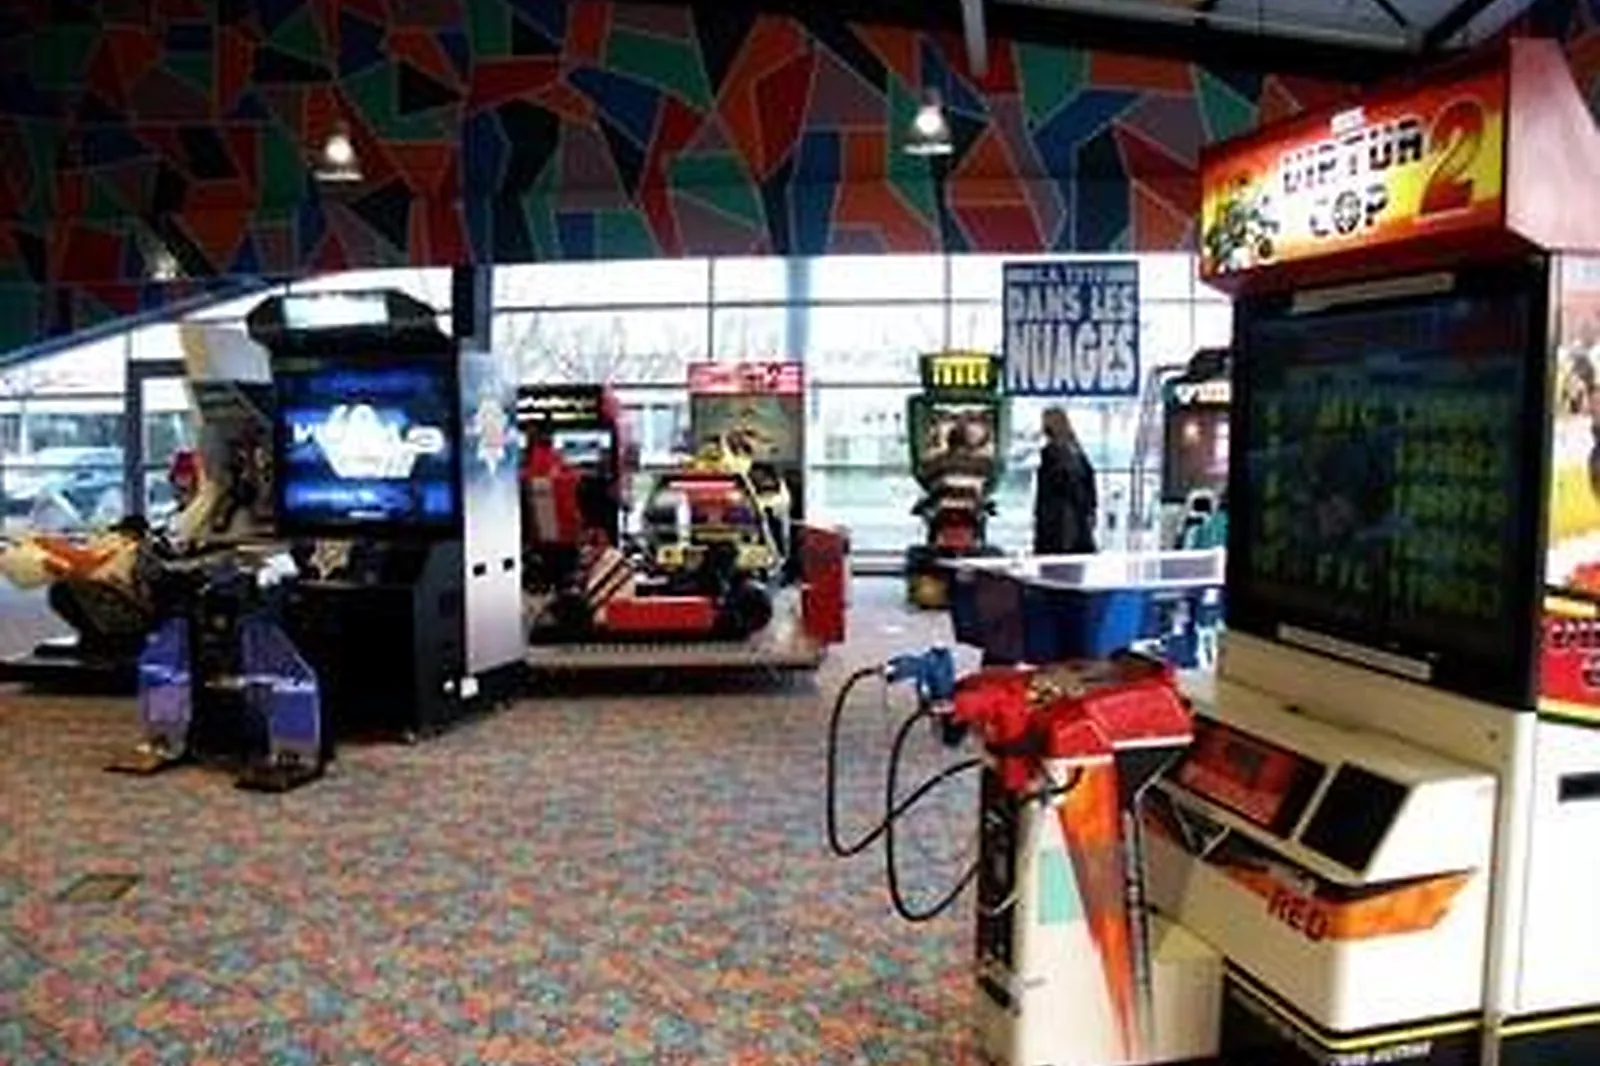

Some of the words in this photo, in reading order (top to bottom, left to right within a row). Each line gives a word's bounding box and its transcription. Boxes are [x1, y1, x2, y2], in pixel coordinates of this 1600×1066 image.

[1420, 95, 1485, 218] 2
[1308, 183, 1389, 237] COP
[1007, 284, 1080, 321] DANS
[1092, 284, 1135, 321] LES
[1006, 322, 1136, 390] NUAGES
